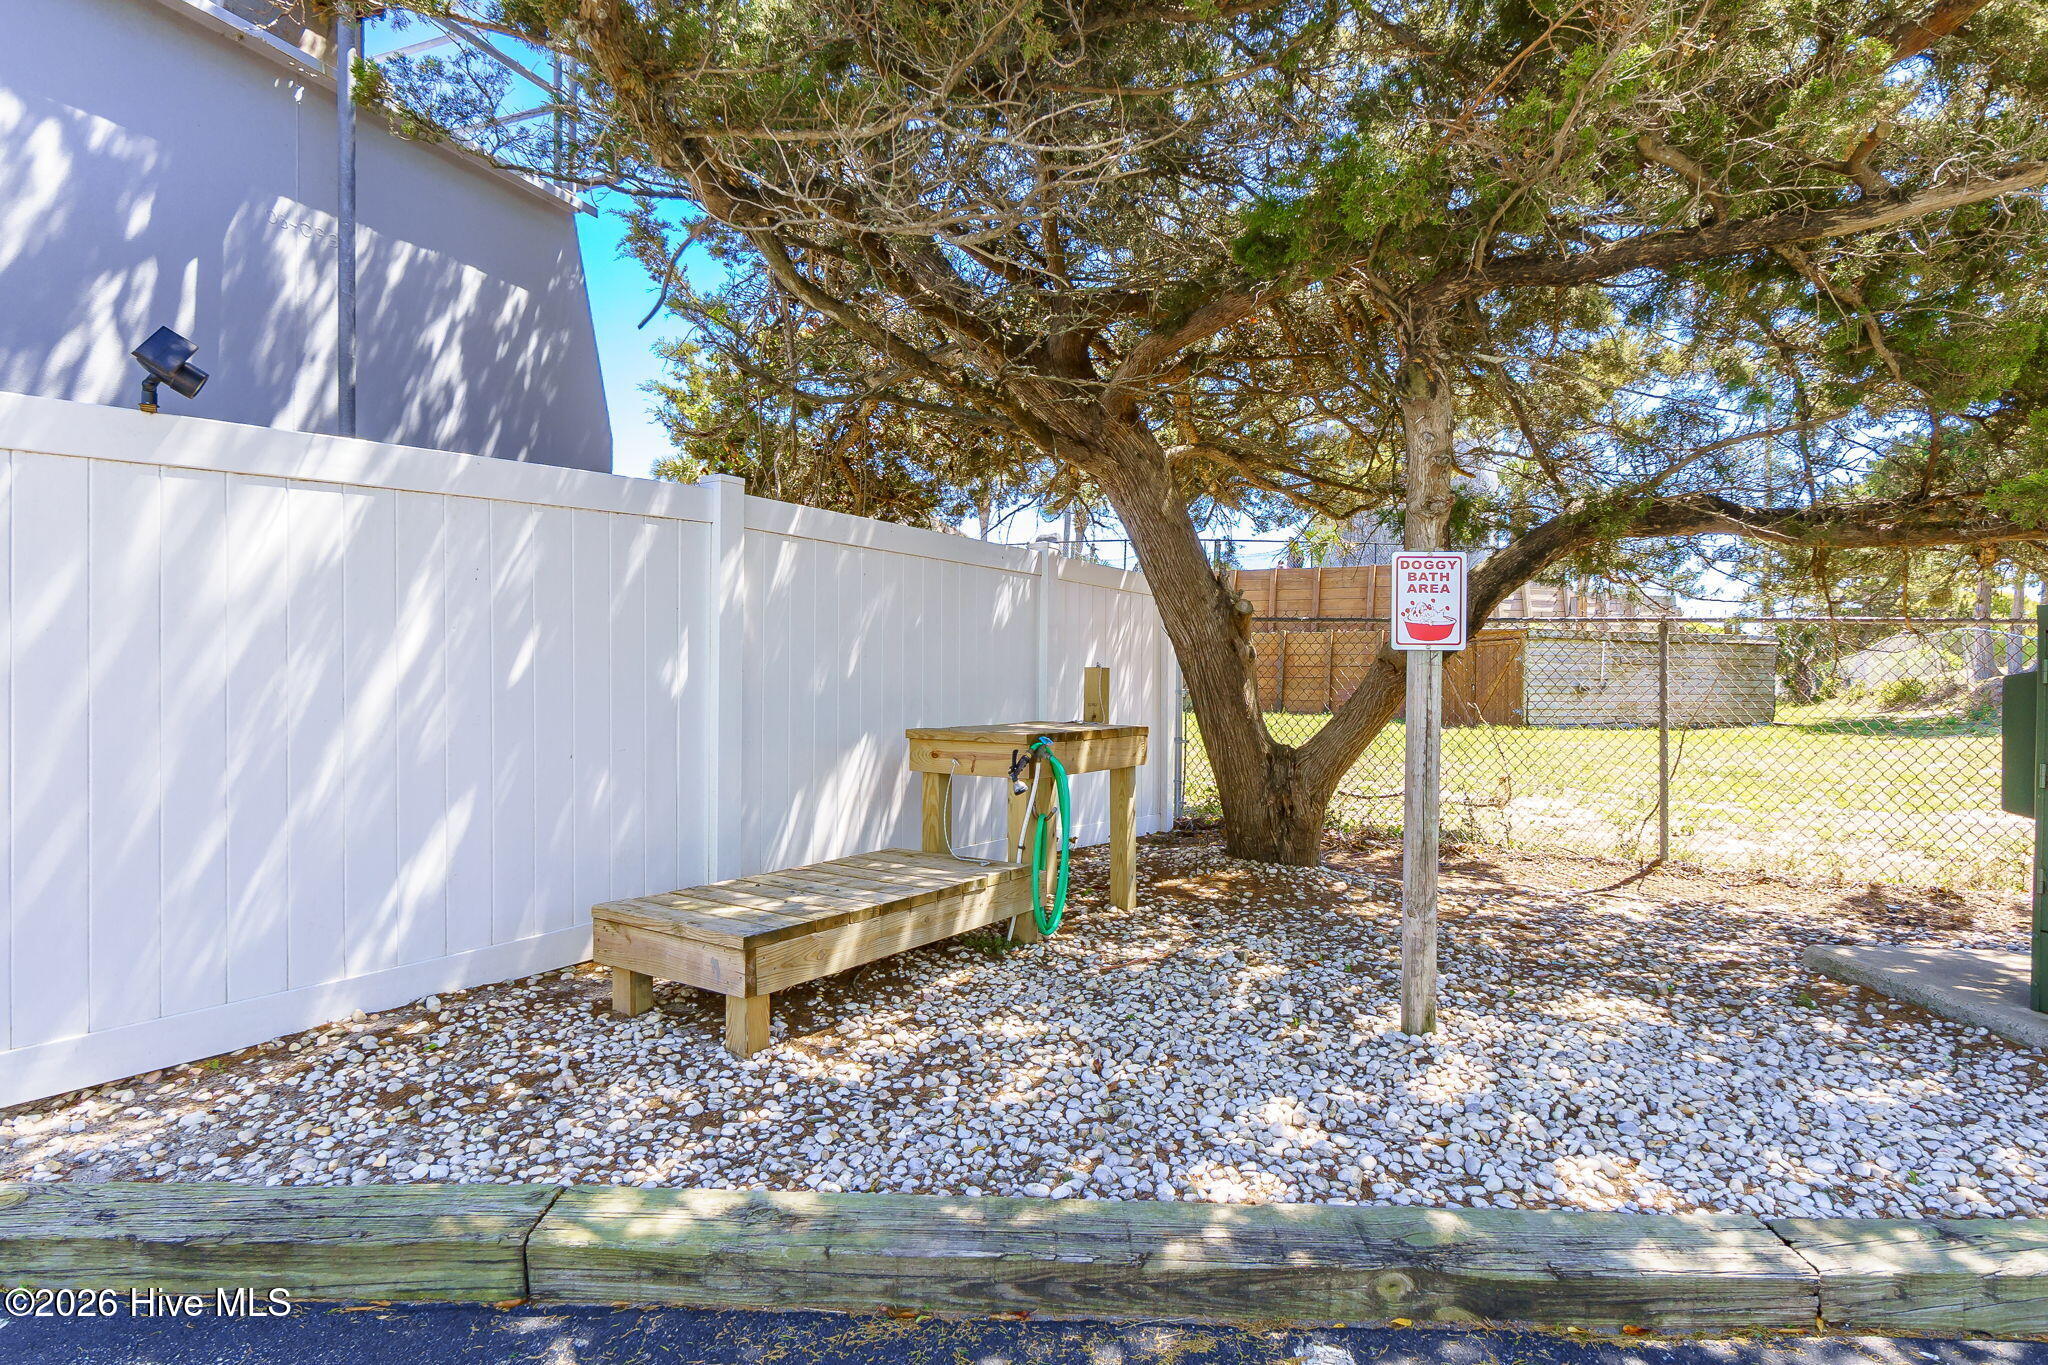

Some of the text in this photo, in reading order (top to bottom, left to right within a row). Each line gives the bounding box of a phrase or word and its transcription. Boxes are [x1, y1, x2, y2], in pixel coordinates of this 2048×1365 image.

[1400, 560, 1458, 570] DOGGY
[1407, 572, 1450, 582] BATH
[1406, 583, 1451, 594] AREA
